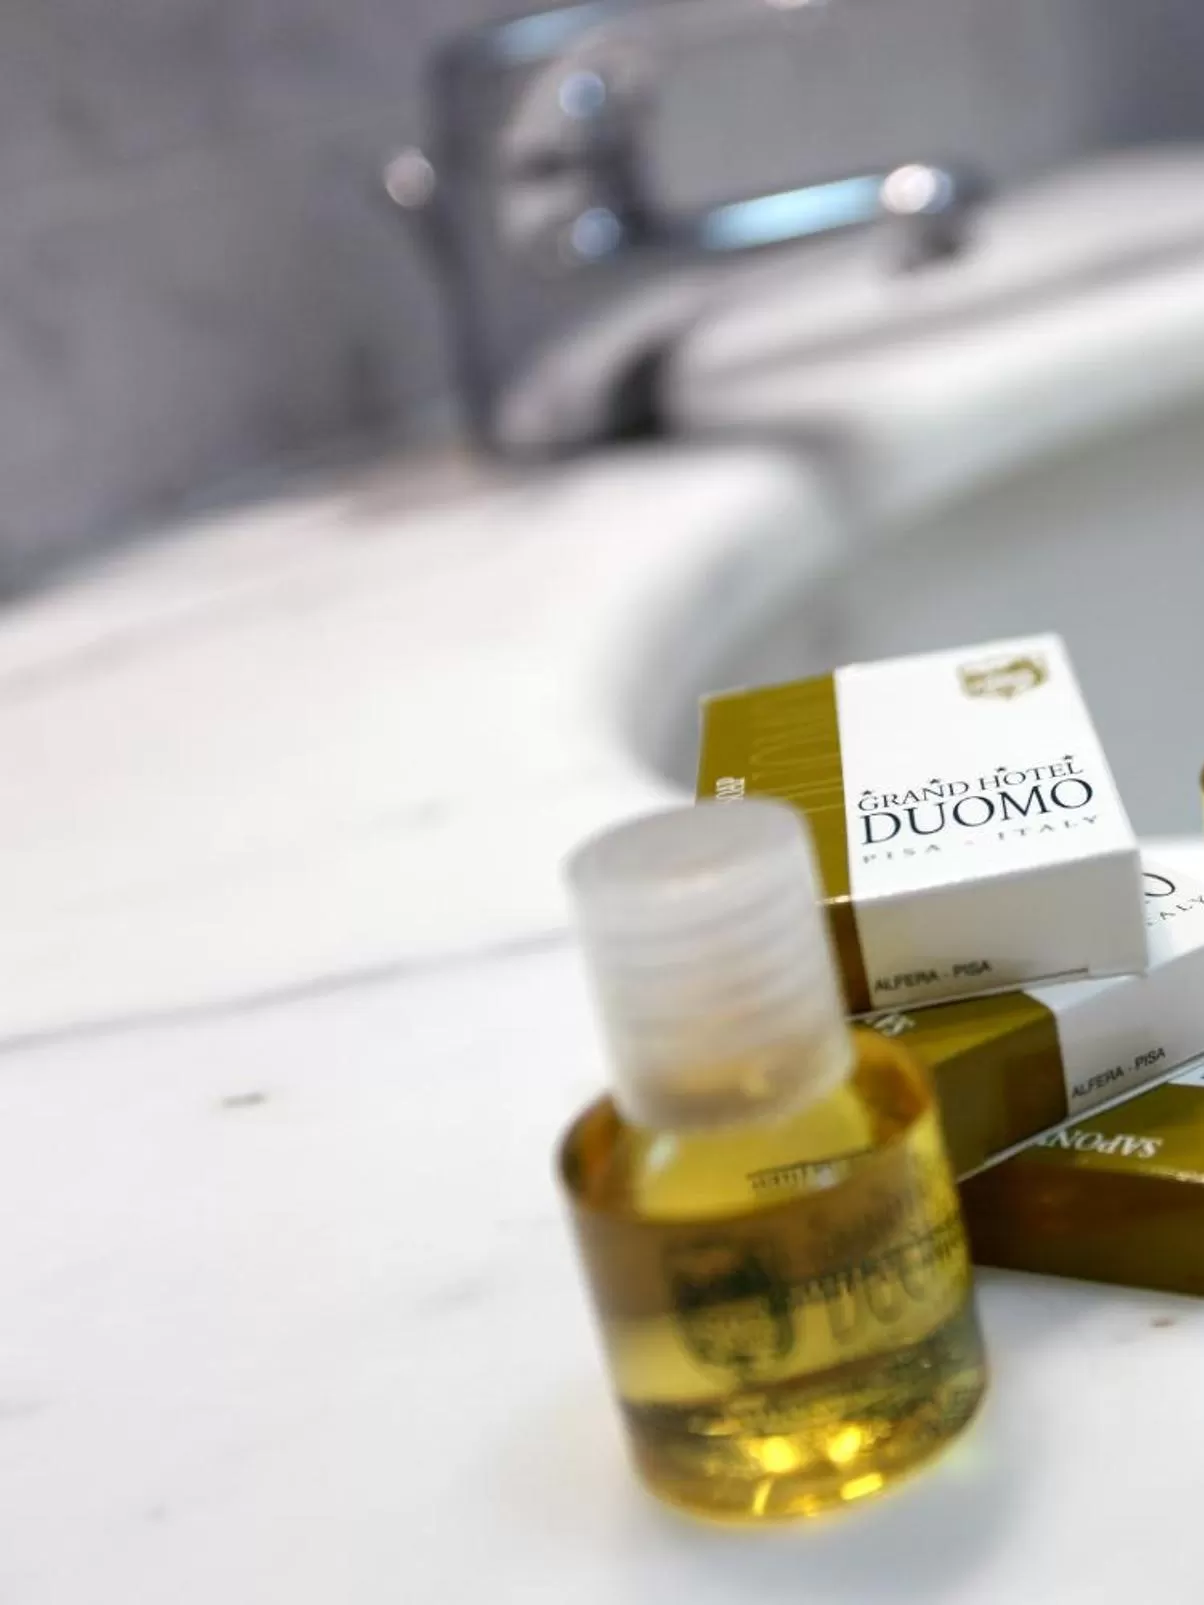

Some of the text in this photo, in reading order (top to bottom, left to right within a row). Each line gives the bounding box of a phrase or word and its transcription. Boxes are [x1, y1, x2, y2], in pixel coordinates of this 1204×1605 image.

[858, 760, 1084, 812] GRAND HOTEL
[860, 777, 1094, 845] DUOMO
[862, 843, 941, 865] PISA
[998, 813, 1098, 841] ITALY
[874, 968, 940, 993] ALFERA
[951, 959, 992, 978] PISA
[1071, 1065, 1125, 1099] ALFERA
[1134, 1046, 1166, 1071] PISA
[1038, 1128, 1164, 1159] SAPON
